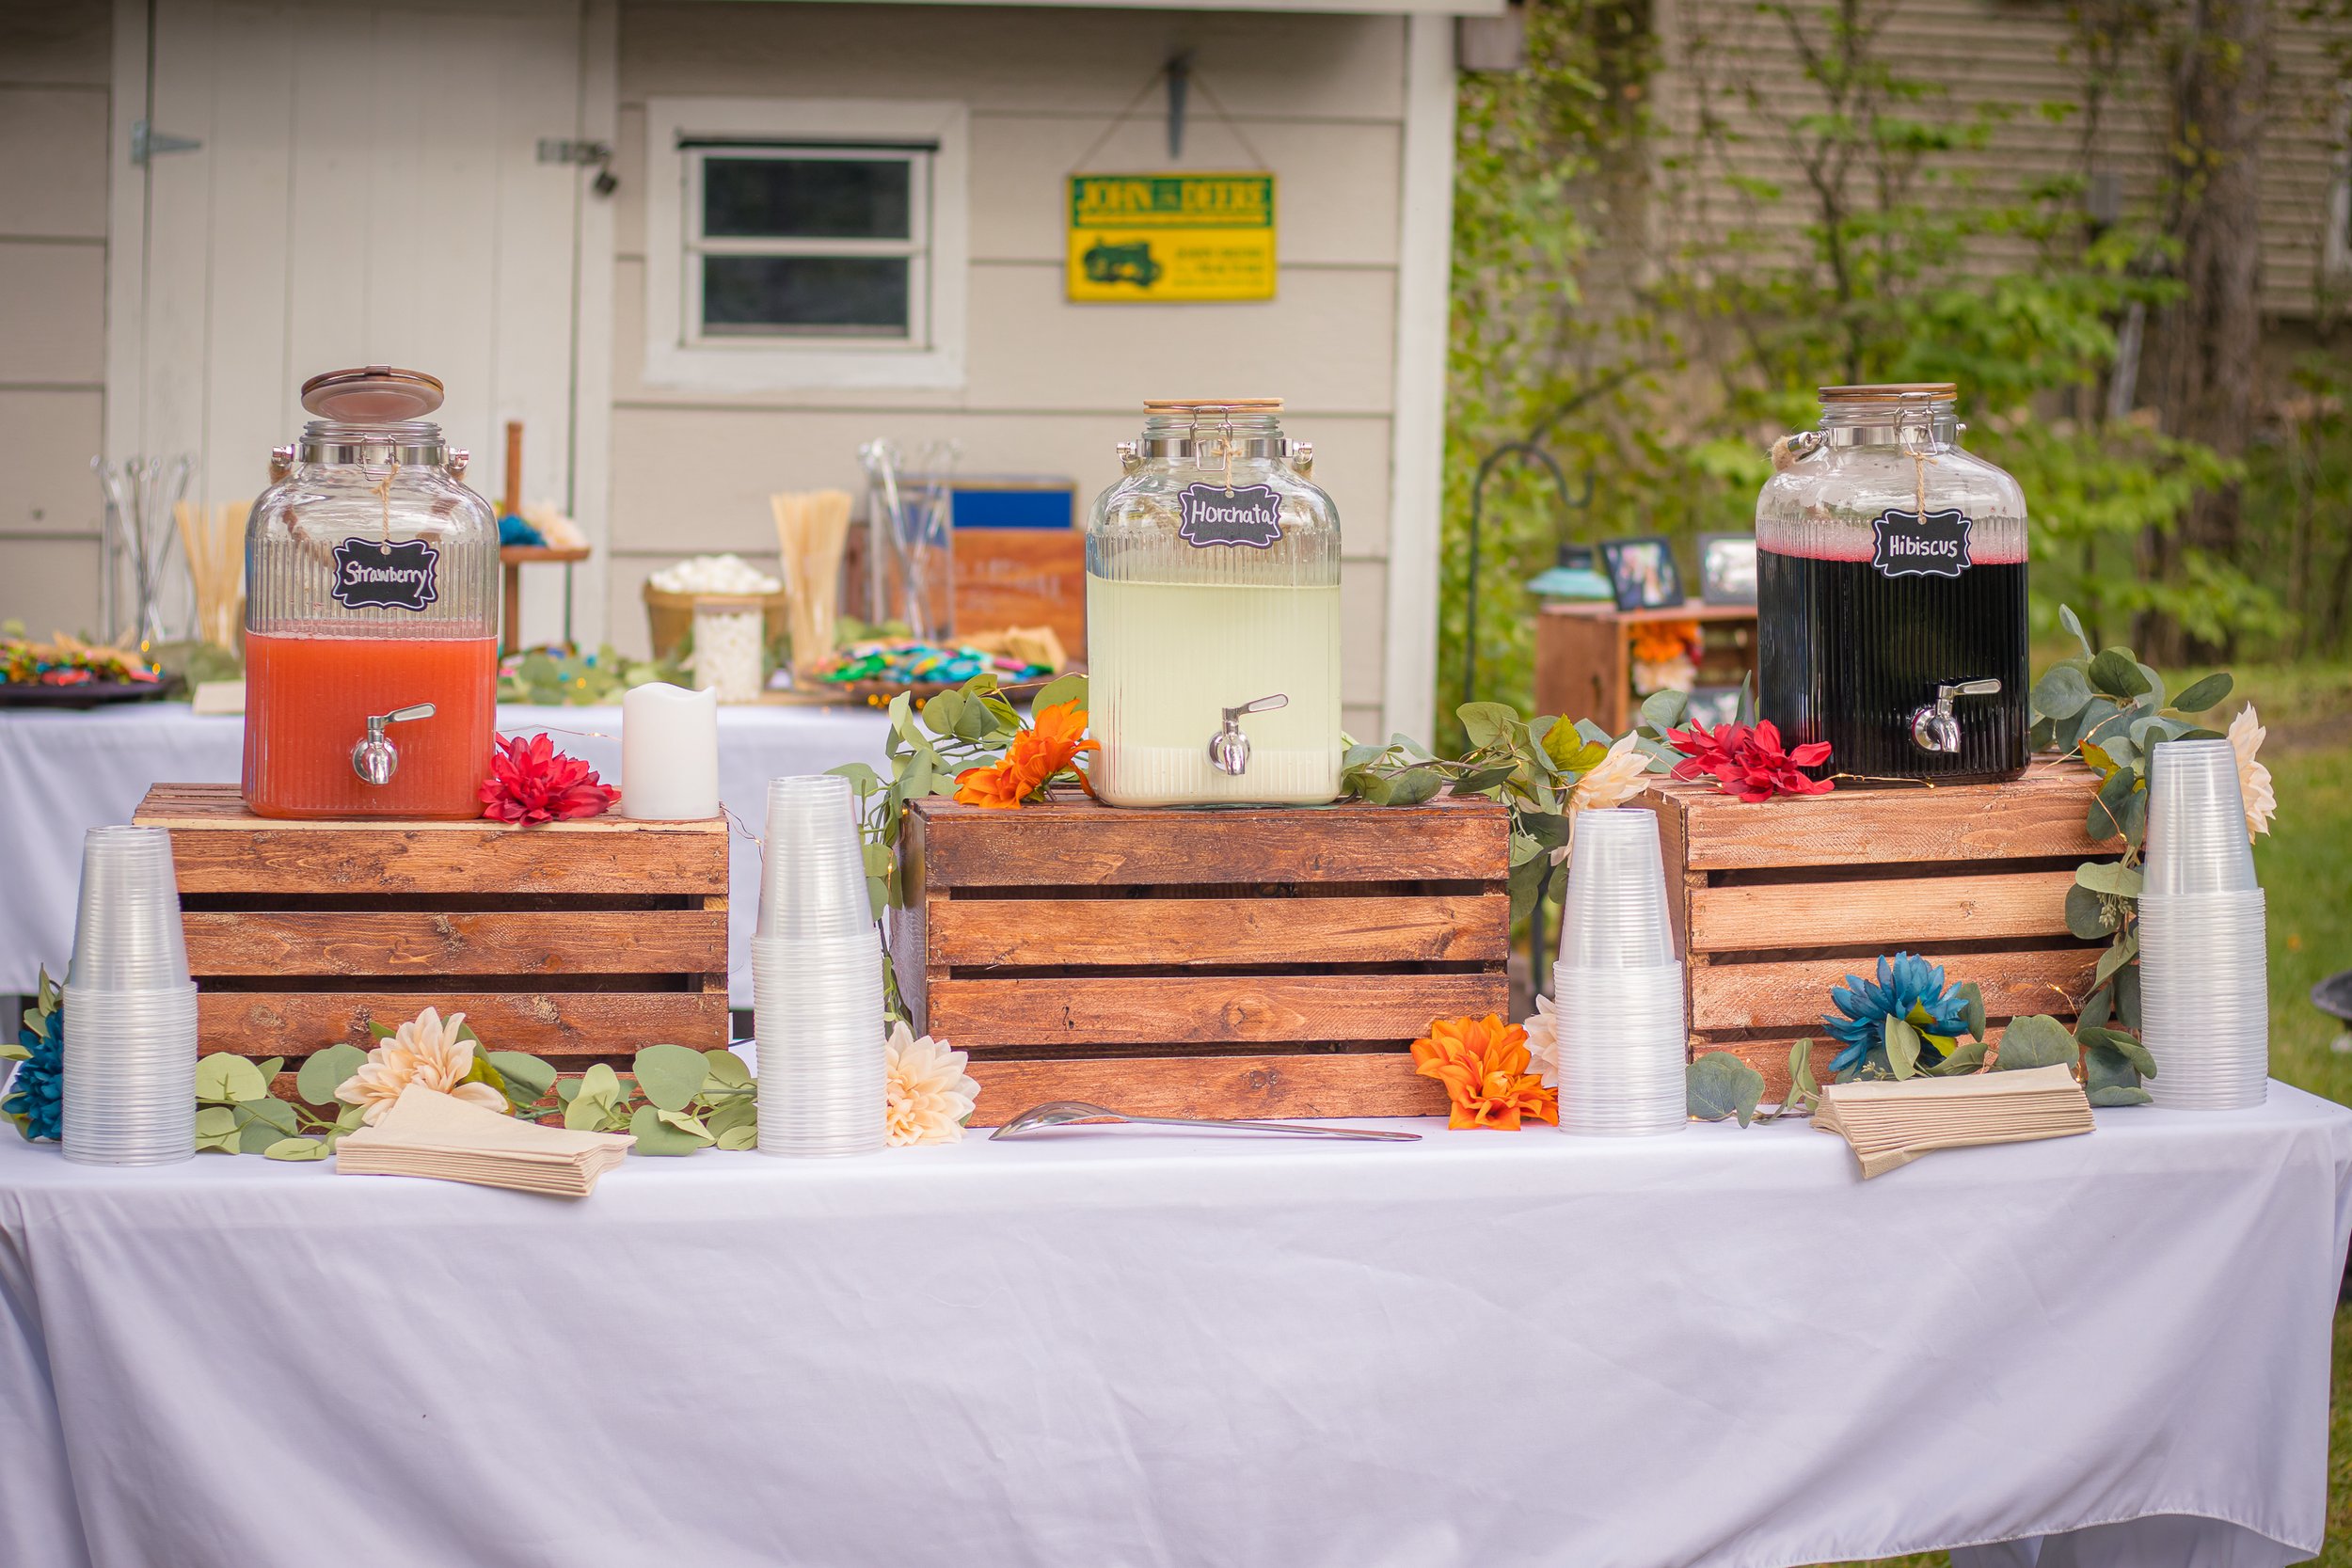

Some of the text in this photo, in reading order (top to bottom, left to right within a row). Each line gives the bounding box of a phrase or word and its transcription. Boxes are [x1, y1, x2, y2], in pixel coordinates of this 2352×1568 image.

[1078, 180, 1265, 212] JOHN DEERE
[1190, 499, 1273, 525] Horchata
[1889, 534, 1959, 558] Hibiscus
[343, 561, 428, 598] Strawberry
